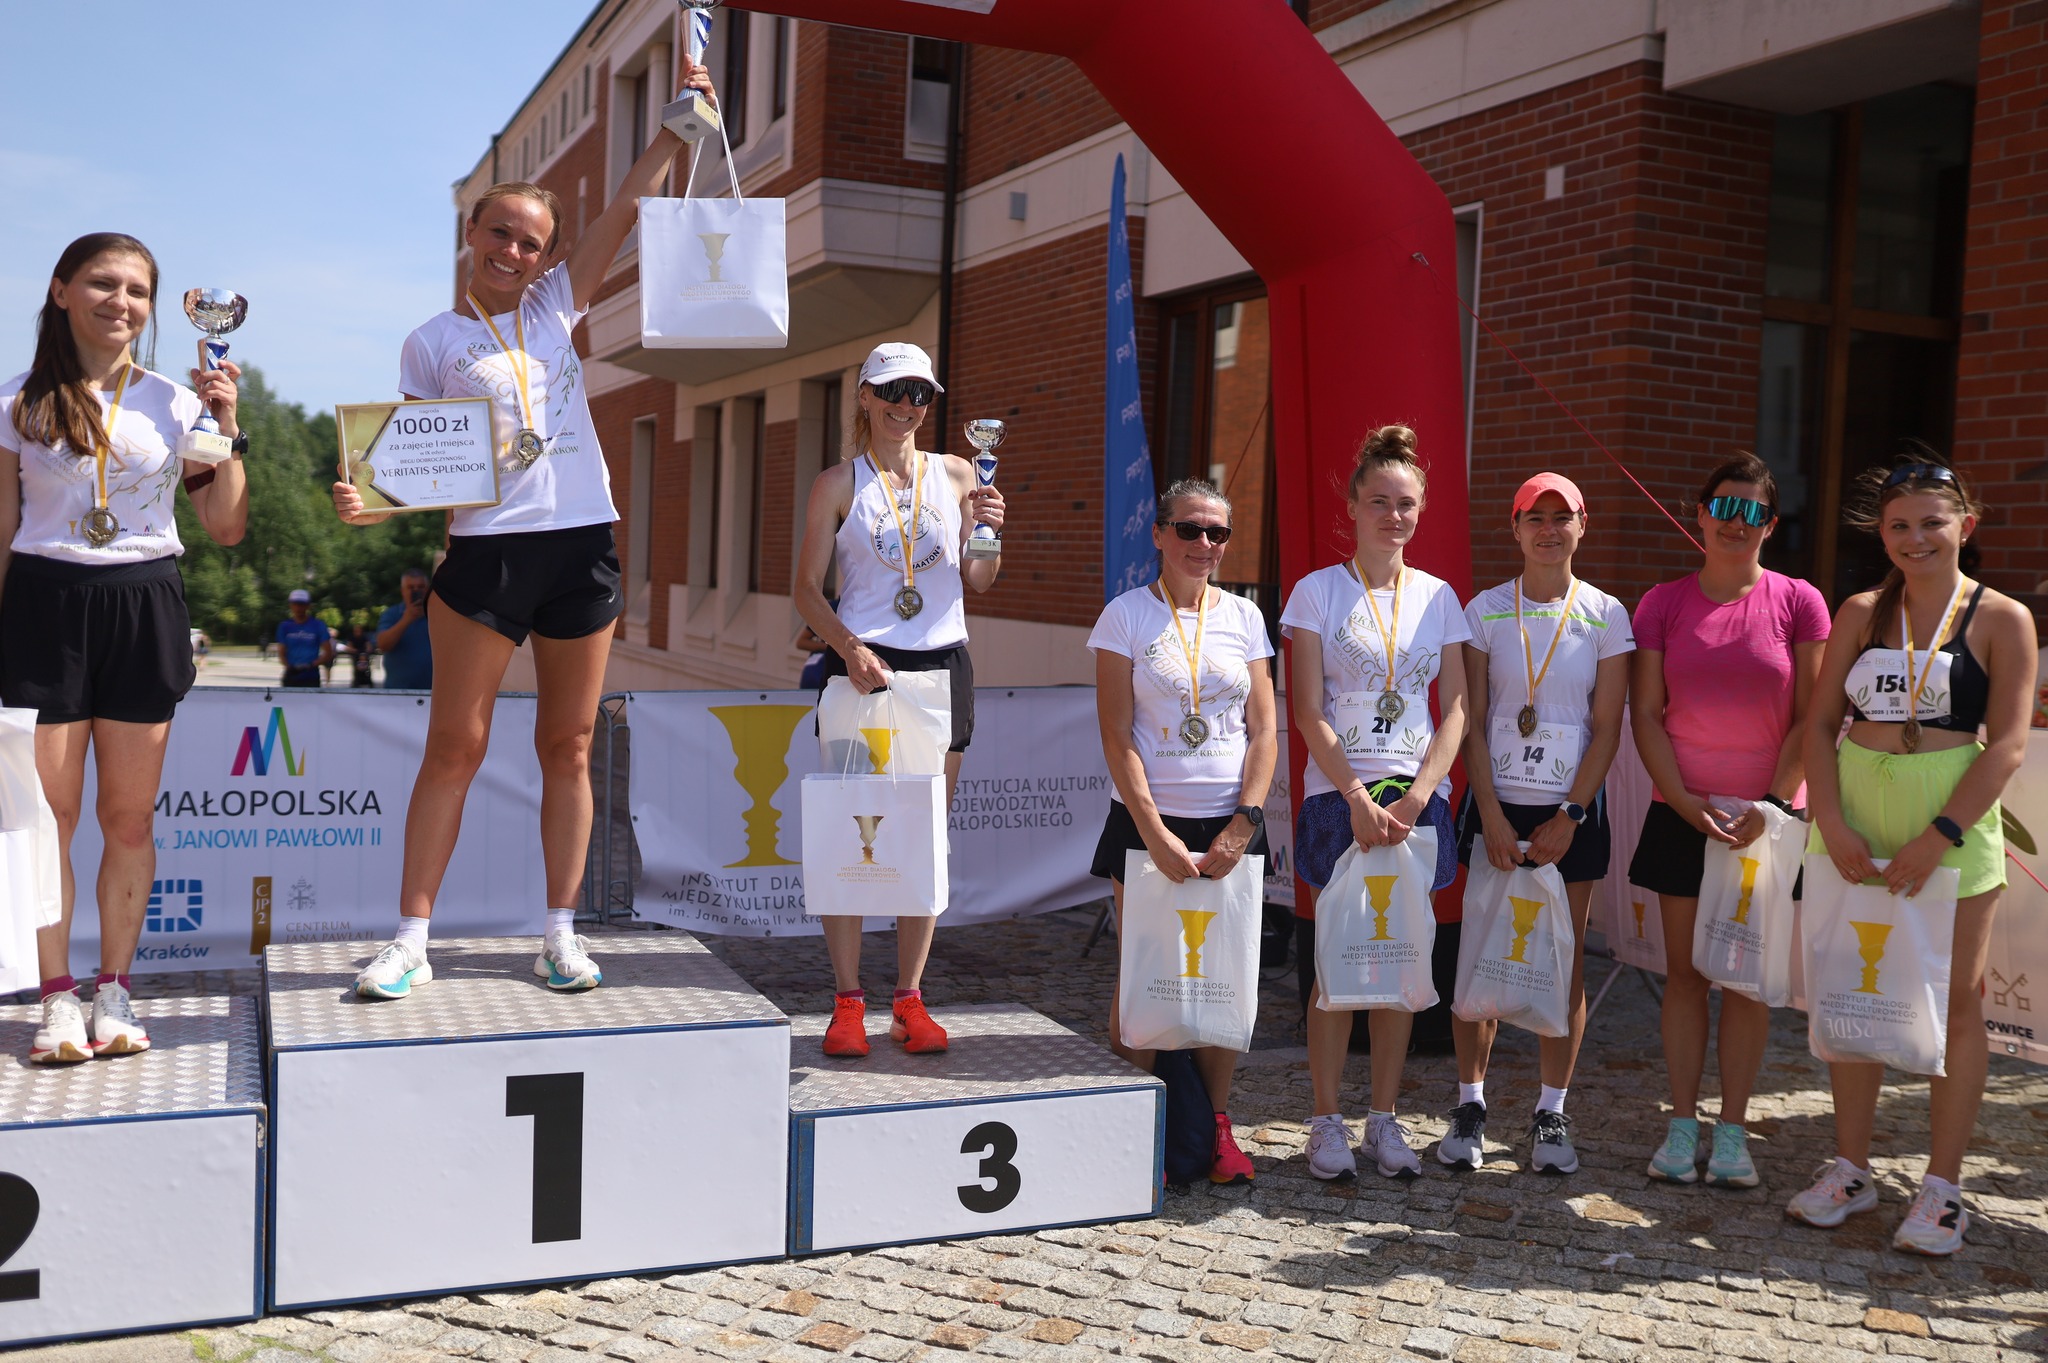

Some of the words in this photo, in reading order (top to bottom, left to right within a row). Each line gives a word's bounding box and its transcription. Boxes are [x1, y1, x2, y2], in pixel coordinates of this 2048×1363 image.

[392, 417, 447, 435] 1000
[451, 415, 469, 432] zł
[402, 441, 433, 450] zajęcie
[440, 439, 475, 447] miejsca
[416, 455, 467, 463] DOBROCZYNNOŚCI
[381, 465, 429, 477] VERITATIS
[432, 462, 486, 475] SPLENDOR
[1342, 640, 1376, 675] BIEG
[1875, 657, 1895, 665] BIEG
[1371, 717, 1392, 734] 21
[1522, 745, 1545, 764] 14
[953, 778, 1032, 794] STYTUCJA
[1038, 776, 1108, 792] KULTURY
[154, 790, 382, 817] MAŁOPOLSKA
[950, 794, 1066, 813] OJEWÓDZTWA
[947, 812, 1073, 831] AŁOPOLSKIEGO
[173, 829, 258, 850] JANOWI
[265, 827, 364, 848] PAWŁOWI
[370, 828, 381, 846] II
[256, 885, 268, 897] C
[255, 898, 270, 913] JP
[257, 912, 267, 925] 2
[668, 904, 690, 918] im.
[695, 909, 729, 924] Jana
[734, 914, 770, 926] Pawła
[286, 921, 351, 932] CENTRUM
[285, 934, 318, 943] JANA
[322, 932, 363, 942] PAWŁA
[135, 944, 209, 961] Kraków
[1474, 964, 1554, 987] MIĘDZYKULTUROWEGO
[1480, 958, 1514, 970] INSTYTUT
[1518, 966, 1551, 978] DIALOGU
[1146, 986, 1236, 998] MIĘDZYKULTUROWEGO
[1153, 979, 1190, 988] INSTYTUT
[1193, 982, 1230, 990] DIALOGU
[1819, 1000, 1918, 1019] MIĘDZYKULTUROWEGO
[1827, 992, 1867, 1004] INSTYTUT
[1871, 998, 1912, 1010] DIALOGU
[1985, 1019, 2034, 1040] OWICE
[506, 1072, 583, 1244] 1
[957, 1120, 1021, 1214] 3
